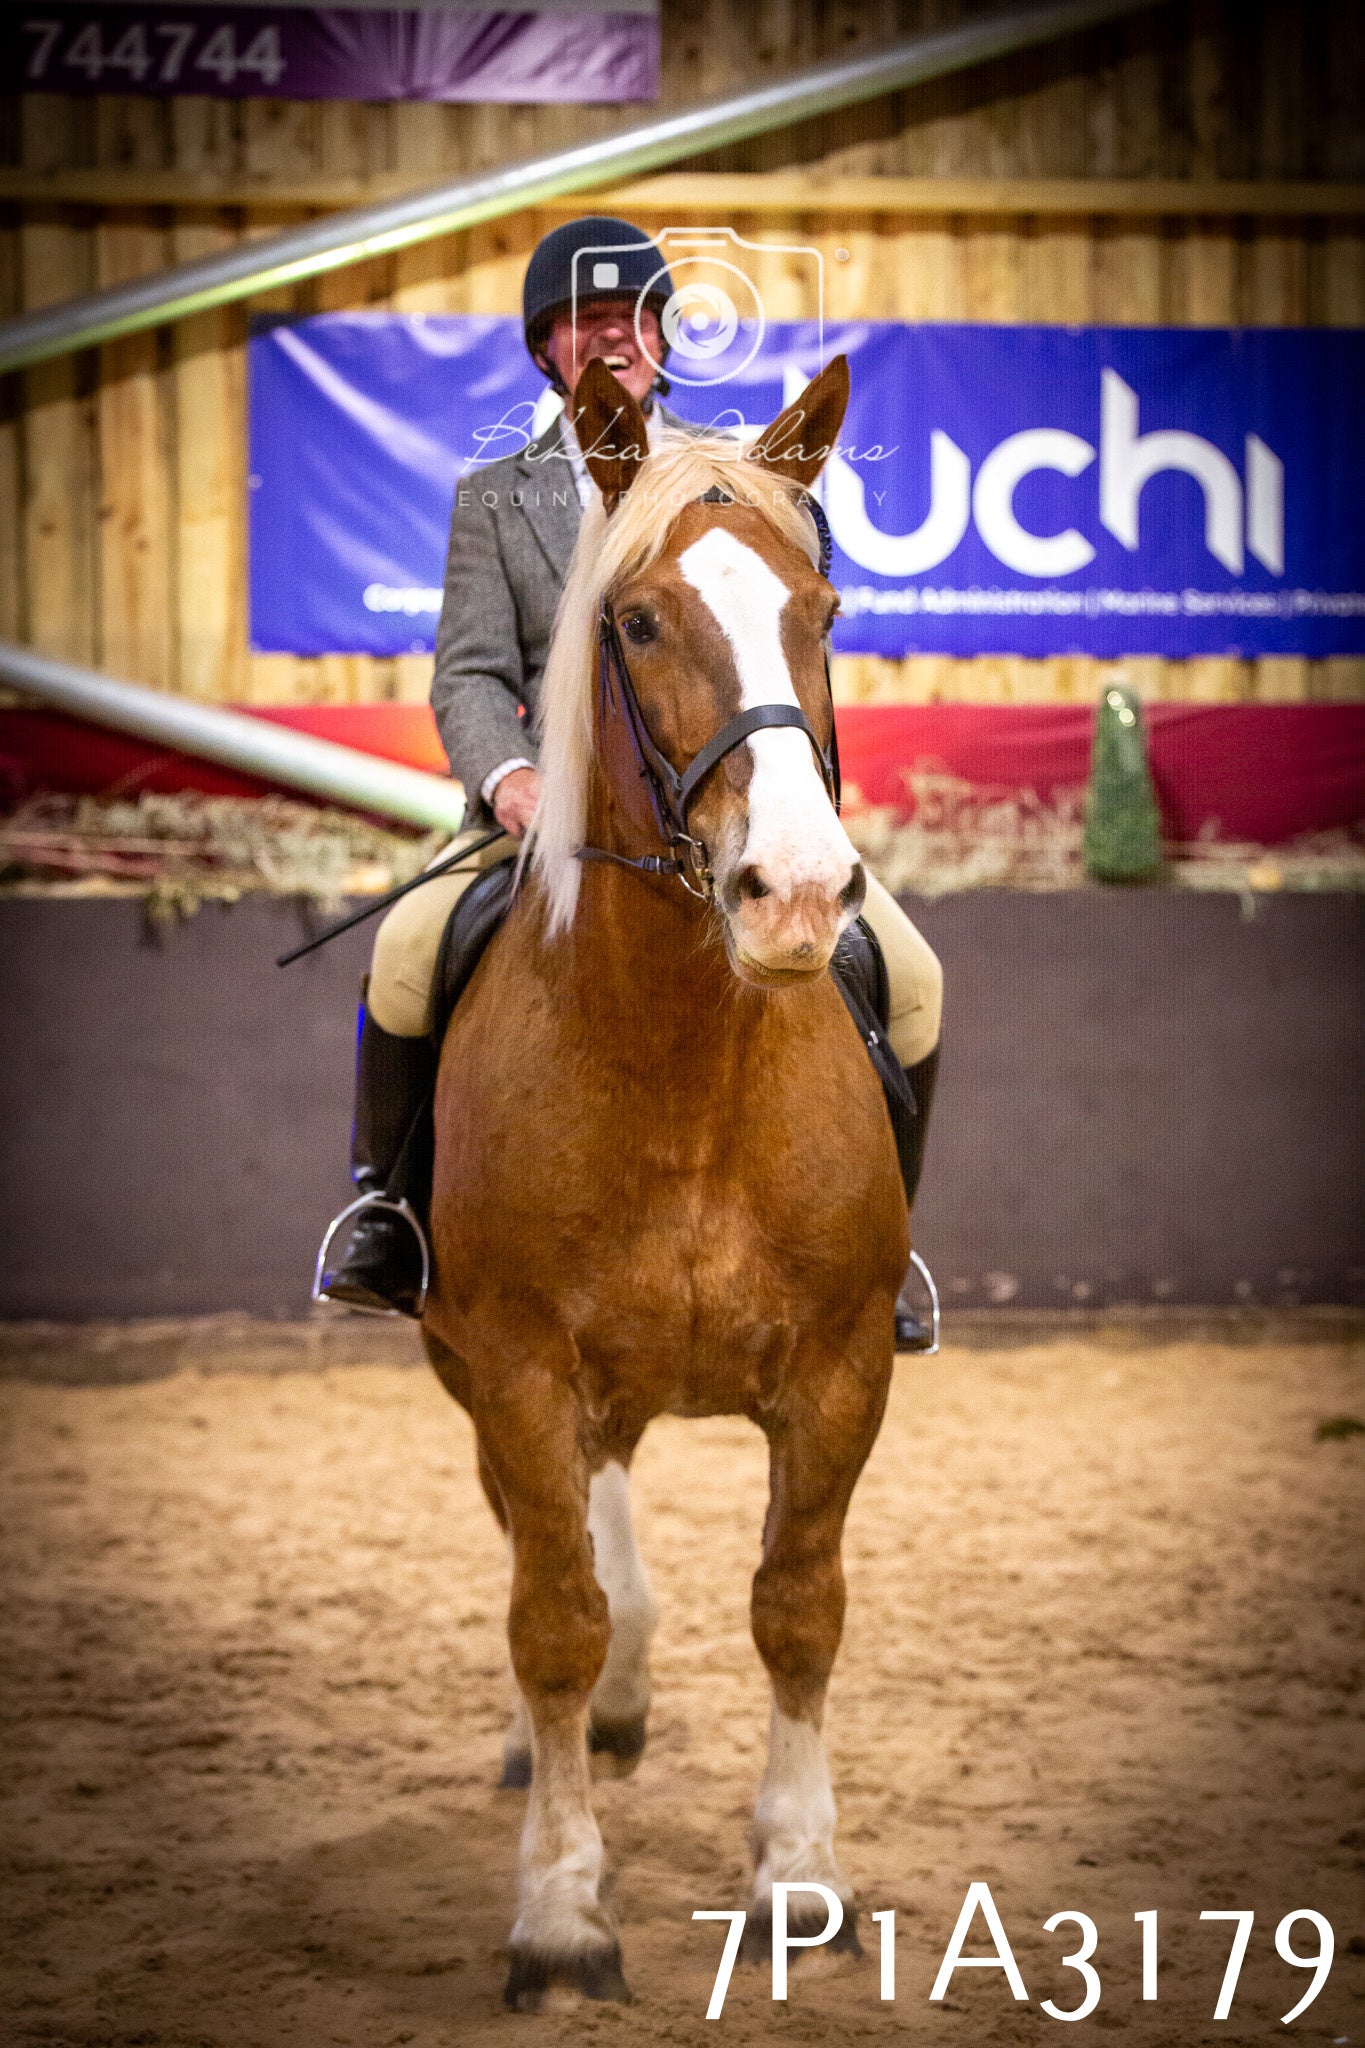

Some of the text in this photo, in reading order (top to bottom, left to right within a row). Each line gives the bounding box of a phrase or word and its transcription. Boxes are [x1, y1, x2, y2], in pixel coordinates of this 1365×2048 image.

[19, 19, 288, 86] 744744
[920, 585, 1083, 615] Administration
[1101, 587, 1178, 617] Marine
[1181, 587, 1277, 617] Services
